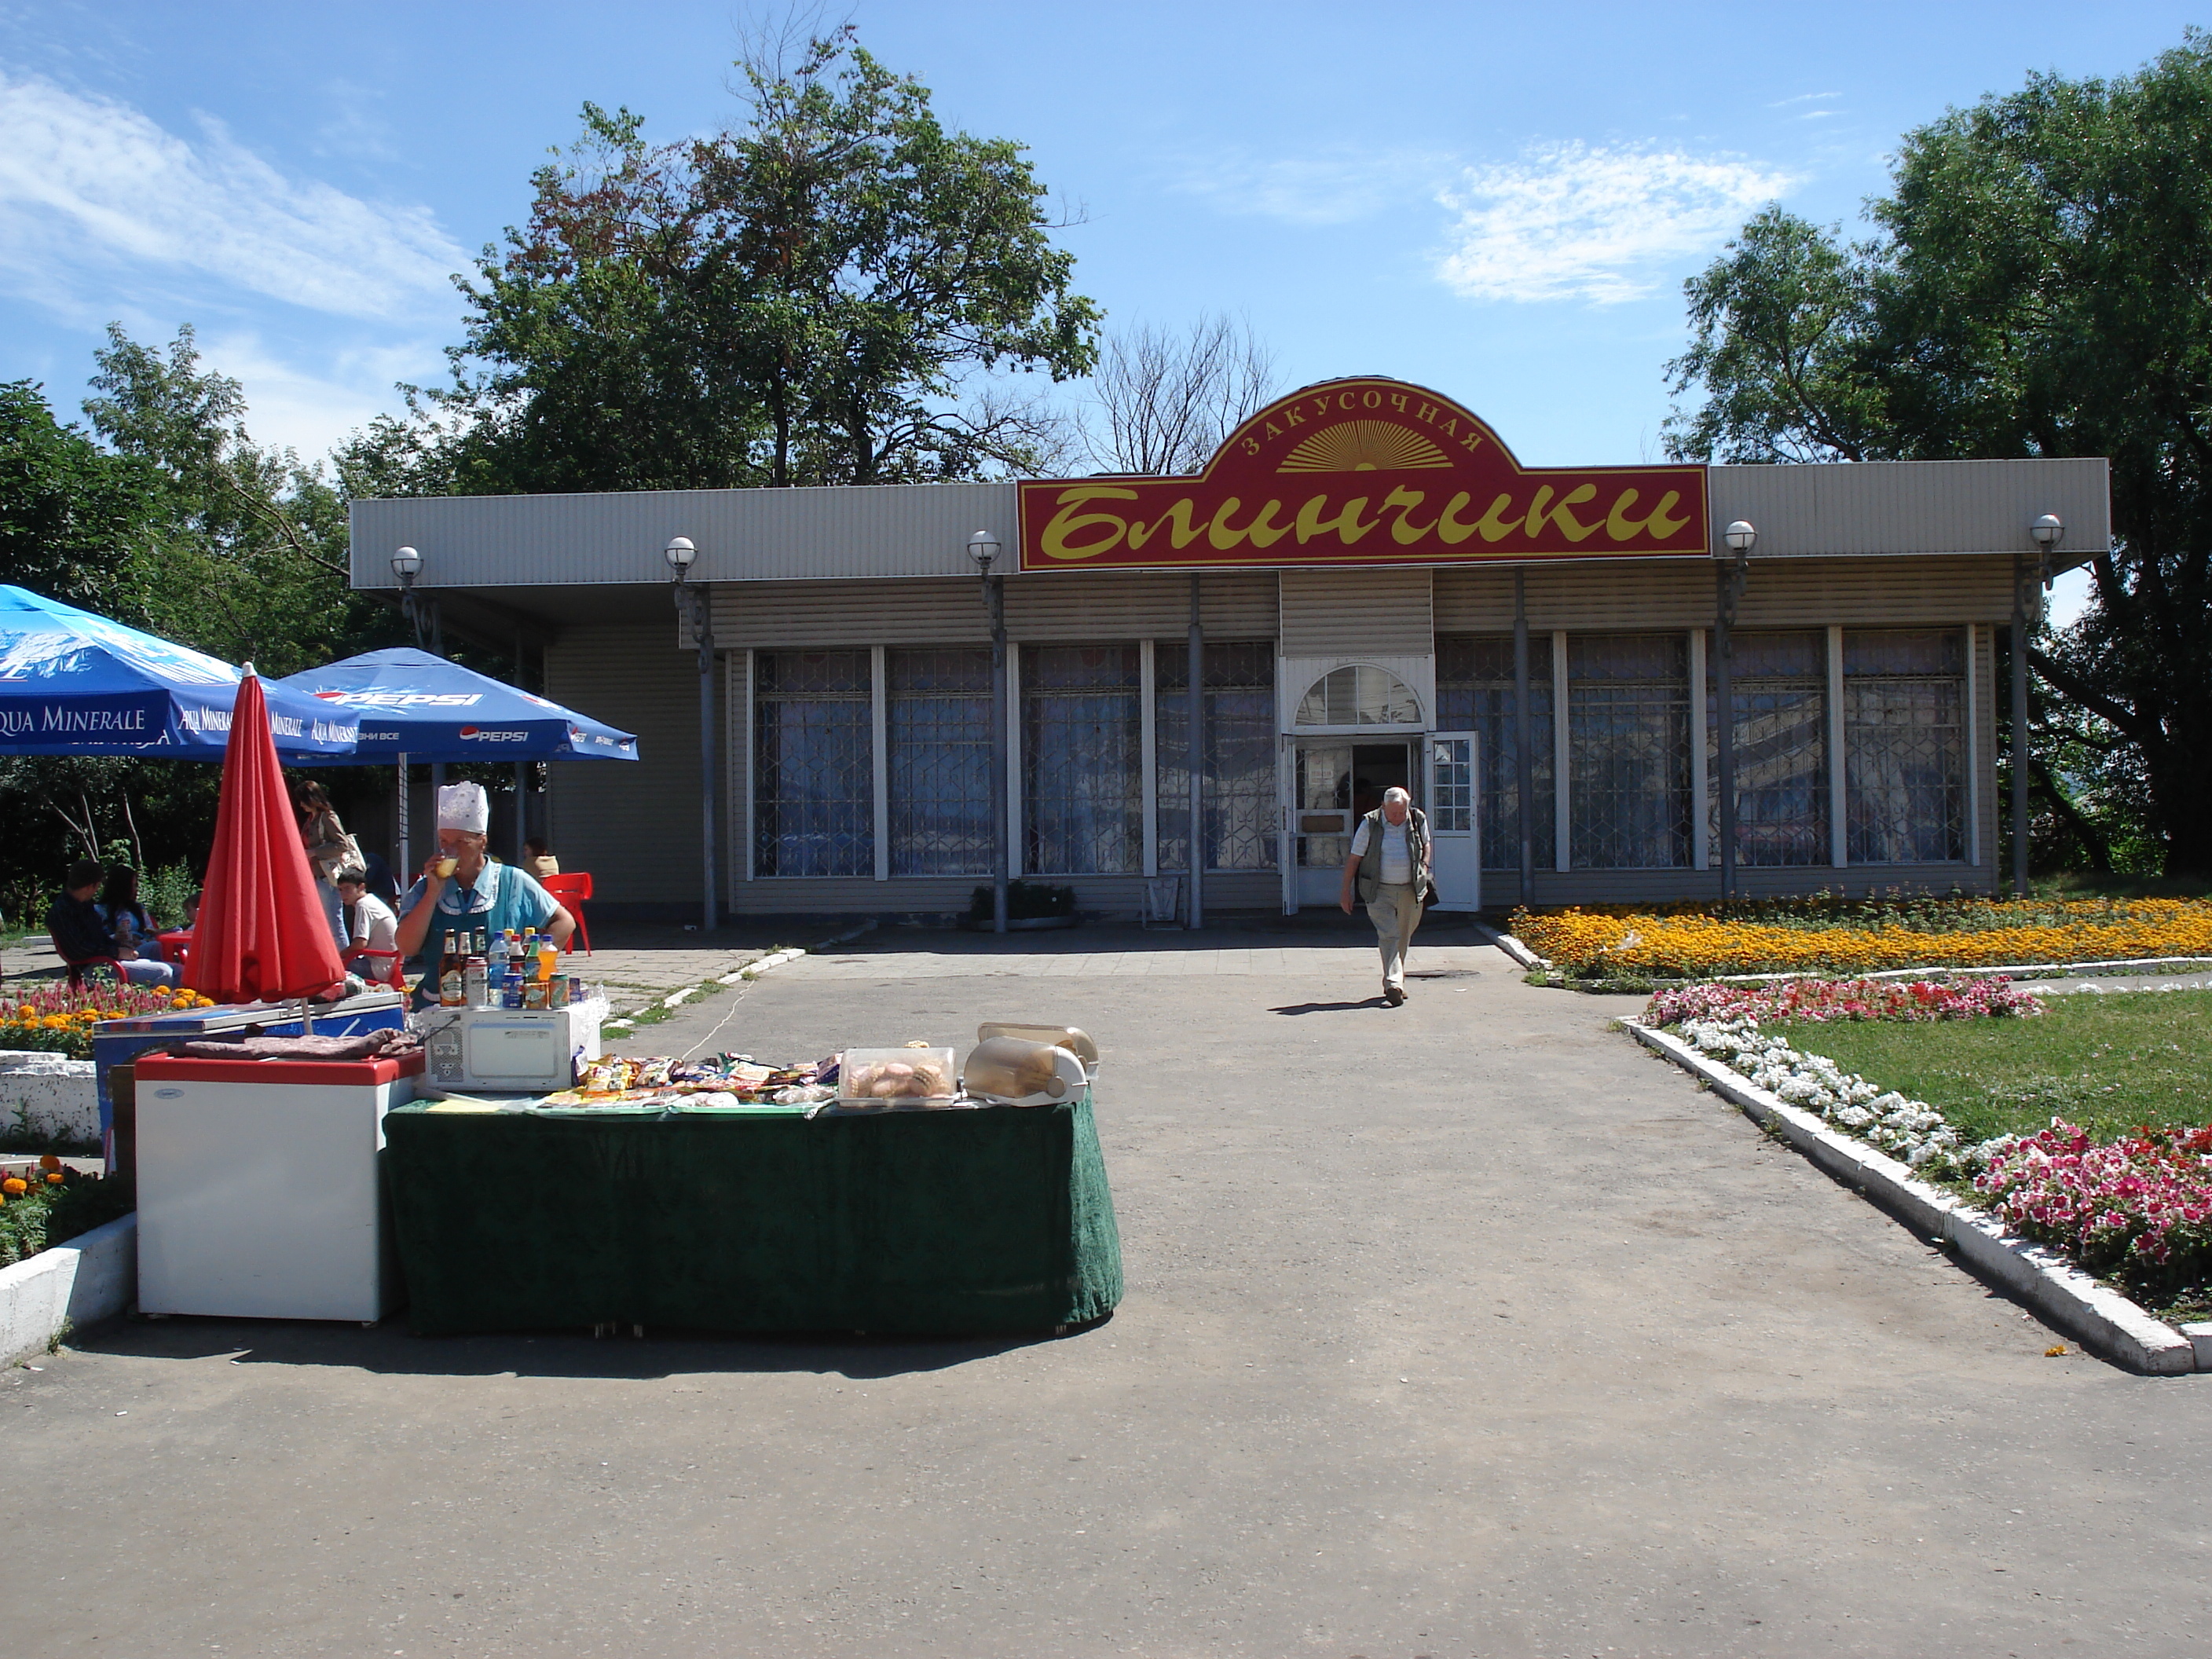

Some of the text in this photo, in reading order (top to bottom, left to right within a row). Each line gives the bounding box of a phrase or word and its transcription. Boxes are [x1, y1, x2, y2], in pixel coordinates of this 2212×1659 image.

[1241, 390, 1484, 456] ЗАКУСОЧНАЯ
[1041, 483, 1691, 560] Блинчики
[335, 694, 484, 705] PEPSI
[42, 705, 145, 731] MINERALE
[271, 711, 303, 737] MINERALE
[478, 731, 529, 742] PEPSI
